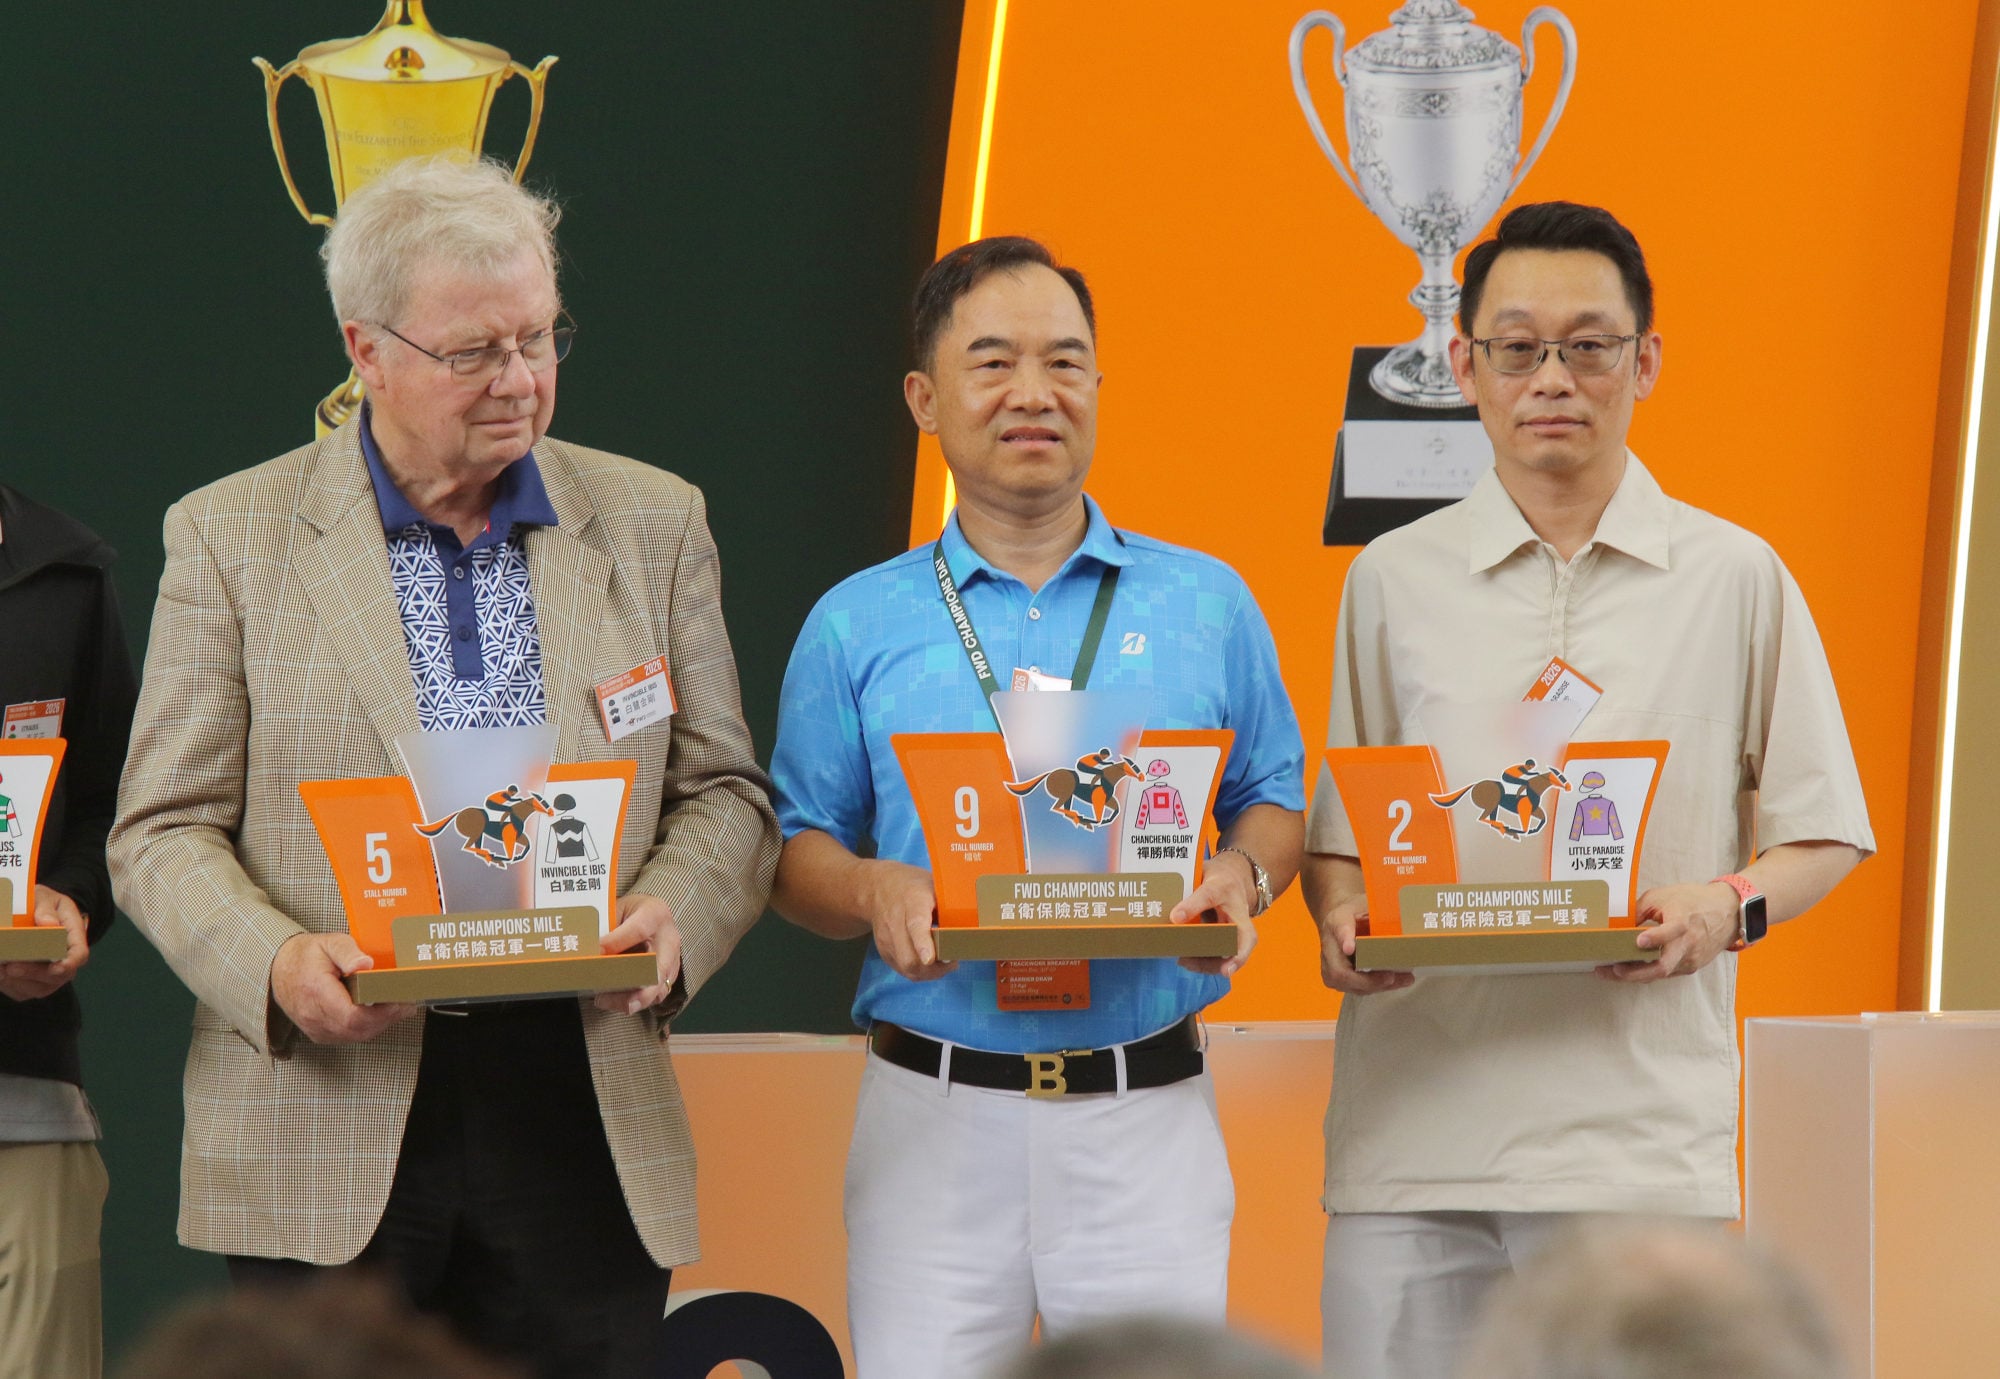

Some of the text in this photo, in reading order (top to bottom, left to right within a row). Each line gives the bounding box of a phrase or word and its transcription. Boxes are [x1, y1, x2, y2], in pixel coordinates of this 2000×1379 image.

[935, 556, 991, 680] FWD CHAMPIONS DAY
[644, 659, 663, 677] 2026
[1541, 662, 1562, 687] 2026
[1014, 674, 1027, 691] 026
[1550, 680, 1570, 702] RADISE
[954, 786, 980, 838] 9
[1388, 799, 1413, 851] 2
[950, 842, 994, 852] STALL NUMBER
[1131, 834, 1194, 844] CHANCHENG GLORY
[365, 832, 392, 885] 5
[1383, 855, 1427, 865] STALL NUMBER
[1568, 845, 1625, 856] LITTLE PARADISE
[541, 863, 606, 878] INVINCIBLE IBIS
[1571, 857, 1623, 870] 小鳥天堂
[363, 887, 407, 899] STALL NUMBER
[1014, 881, 1148, 899] FWD CHAMPIONS MILE
[1437, 889, 1572, 908] FWD CHAMPIONS MILE
[1000, 900, 1162, 920] 富衛保險冠軍一哩賽
[1423, 908, 1588, 929] 富衛保險冠軍一哩賽
[429, 915, 563, 939] FWD CHAMPIONS MILE
[416, 935, 579, 961] 富衛保險冠軍一哩賽
[1024, 1053, 1067, 1099] B
